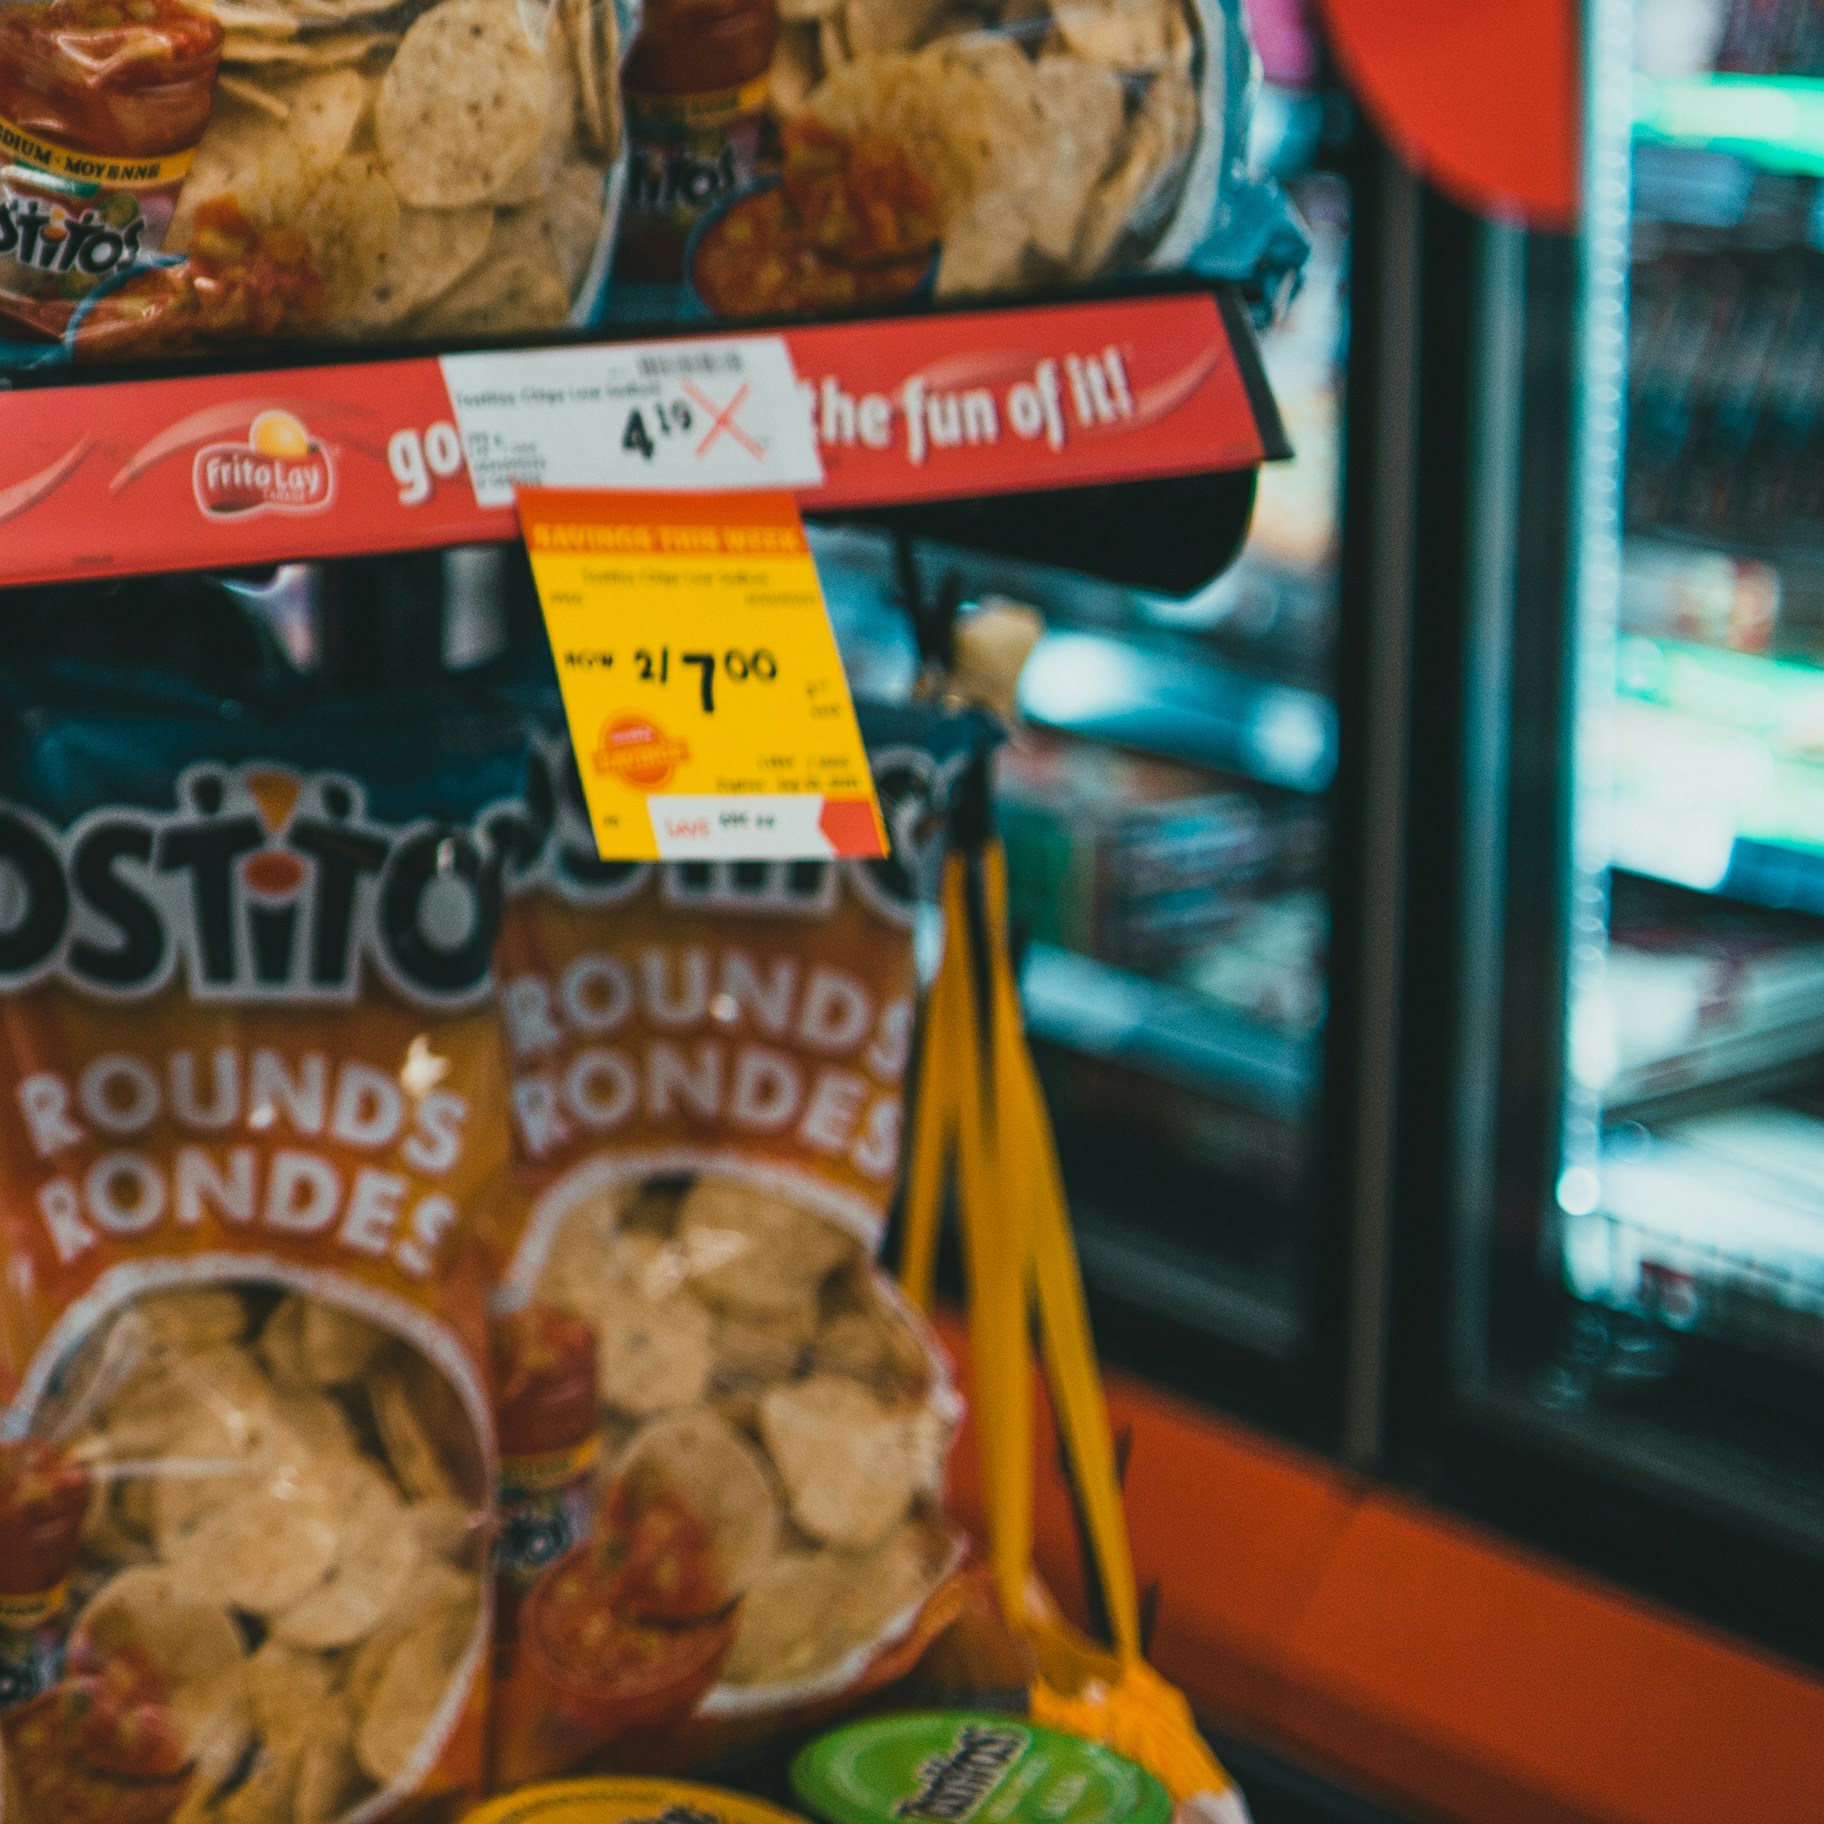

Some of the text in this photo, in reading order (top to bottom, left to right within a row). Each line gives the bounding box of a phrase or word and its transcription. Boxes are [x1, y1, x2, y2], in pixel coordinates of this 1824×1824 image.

[388, 422, 461, 507] go
[904, 375, 999, 467] fun
[1009, 357, 1065, 453] of
[1065, 345, 1133, 425] it!
[501, 949, 909, 1081] ROUNDS
[19, 1046, 466, 1173] ROUNDS
[513, 1042, 900, 1174] RONDES
[37, 1147, 457, 1279] RONDES
